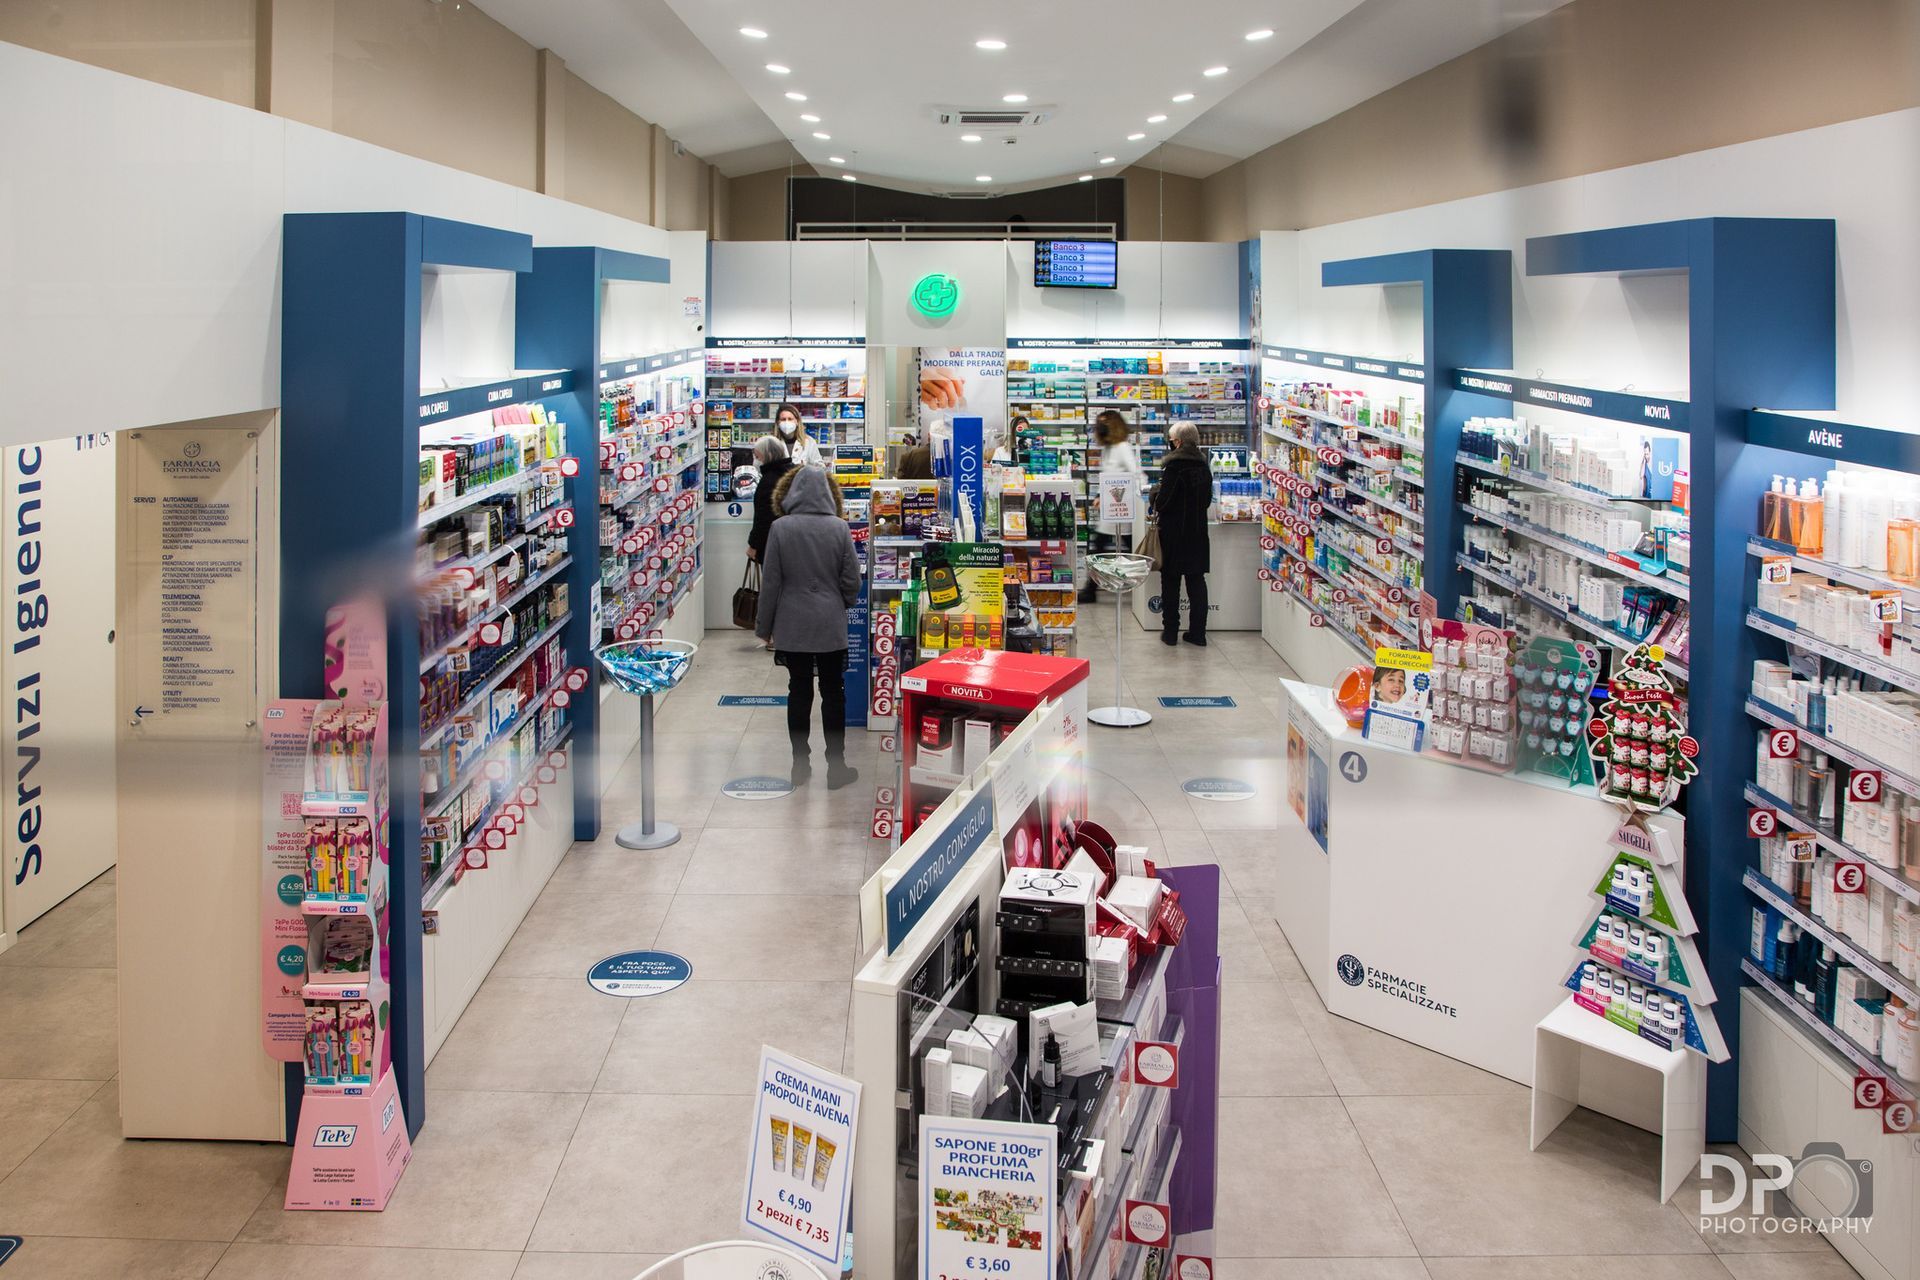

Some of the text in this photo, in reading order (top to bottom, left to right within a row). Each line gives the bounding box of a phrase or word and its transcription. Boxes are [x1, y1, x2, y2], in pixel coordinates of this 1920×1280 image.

[1530, 388, 1592, 408] FARMACISTI PREPARATORI
[432, 401, 448, 415] CAPELLI
[1645, 404, 1670, 420] NOVITÀ
[1808, 428, 1842, 448] AVÈNE
[731, 504, 739, 516] 1
[14, 445, 48, 886] Servizi Igienic
[1388, 651, 1422, 661] FORATURA
[1398, 659, 1430, 669] ORECCHIE
[951, 686, 983, 698] NOVITÀ
[1624, 691, 1662, 700] Buone Feste
[1777, 736, 1790, 752] €
[1344, 755, 1361, 780] 4
[1858, 776, 1872, 796] €
[1756, 814, 1768, 831] €
[1619, 830, 1651, 851] SAUGELLA
[899, 806, 986, 922] IL NOSTRO CONSIGLIO
[287, 882, 304, 890] 4,99
[1843, 868, 1856, 888] €
[1368, 967, 1426, 995] FARMACIE
[1368, 979, 1457, 1018] SPECIALIZZATE
[775, 1070, 841, 1107] CREMA MANI
[1862, 1084, 1876, 1102] €
[764, 1081, 850, 1126] PROPOLI E AVENA
[1892, 1107, 1906, 1126] €
[321, 1130, 350, 1142] TePe
[935, 1138, 1043, 1158] SAPONE 100gr
[950, 1152, 1028, 1169] PROFUMA
[942, 1165, 1035, 1182] BIANCHERIA
[779, 1189, 812, 1214] € 4,90
[757, 1199, 829, 1243] 2 pezzi € 7,35
[966, 1257, 1010, 1272] € 3,60
